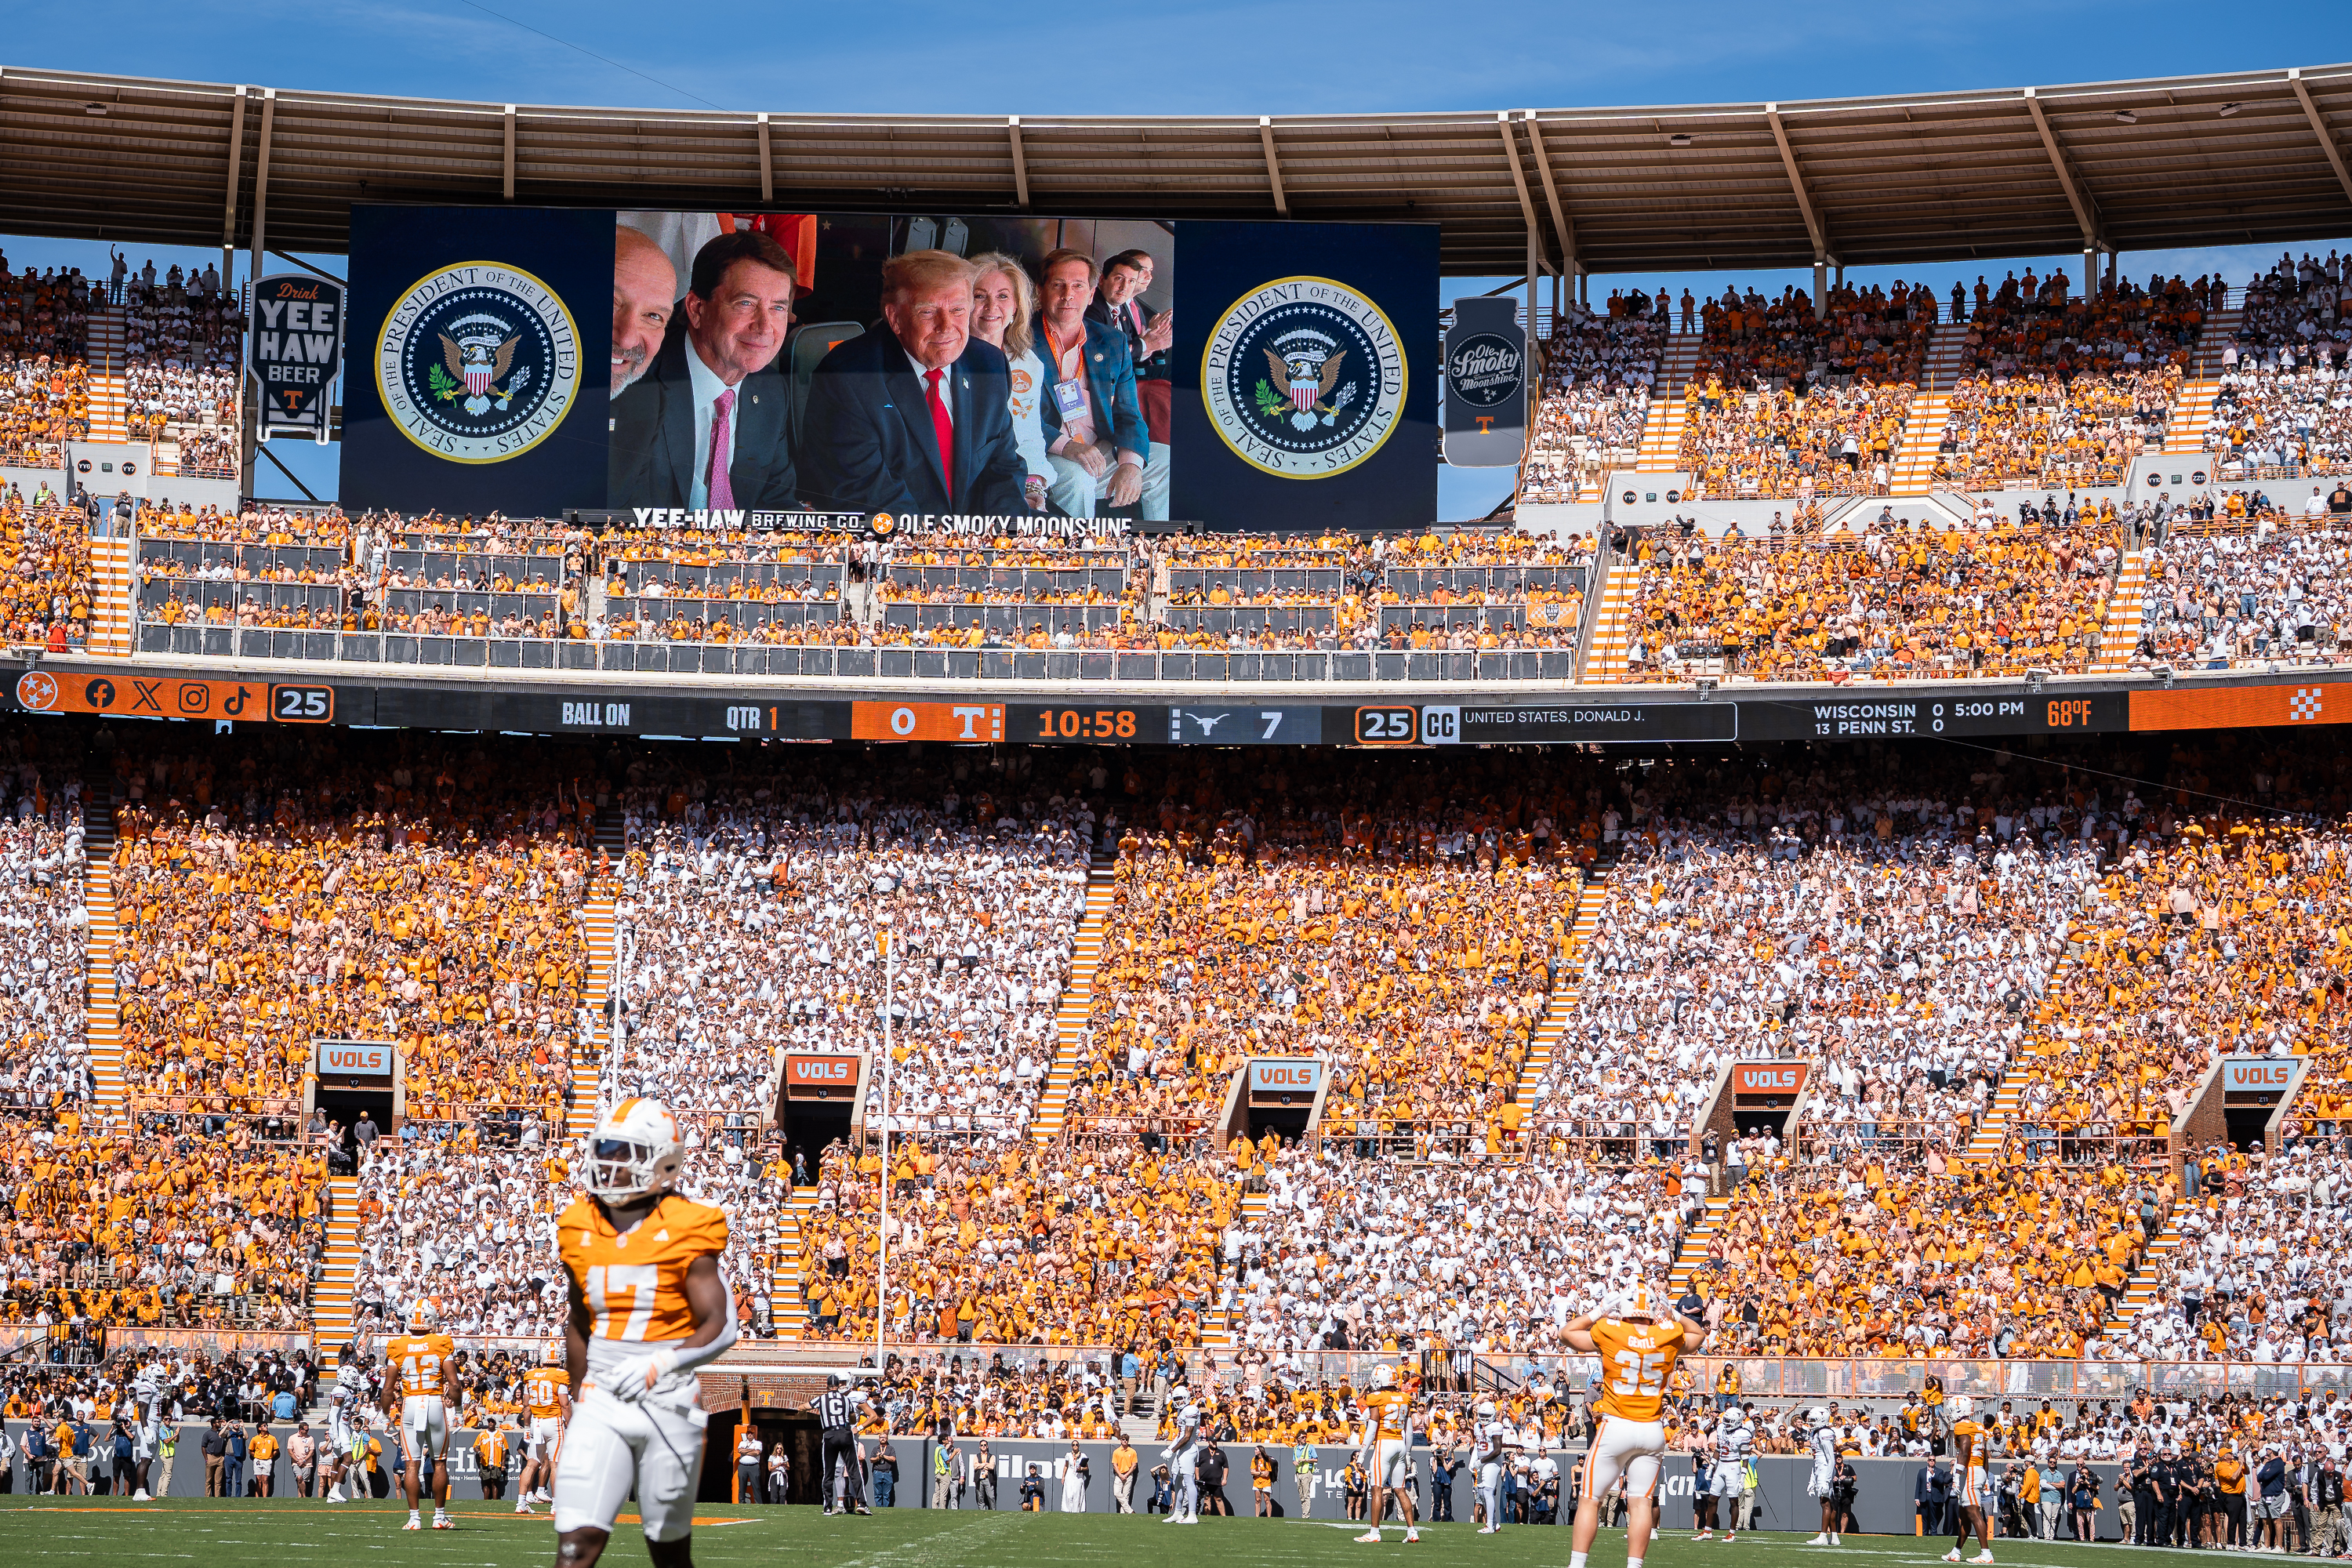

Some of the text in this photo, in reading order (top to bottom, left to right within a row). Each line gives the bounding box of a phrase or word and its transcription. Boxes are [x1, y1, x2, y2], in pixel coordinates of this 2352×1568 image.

[486, 271, 506, 283] OF
[509, 276, 535, 297] THE
[277, 282, 319, 300] Drink
[1309, 286, 1330, 298] OF
[1333, 291, 1360, 313] THE
[259, 299, 334, 332] YEE
[383, 267, 478, 354] PRESIDENT
[536, 293, 575, 379] UNITED
[1209, 283, 1302, 370] PRESIDENT
[260, 331, 335, 364] HAW
[1361, 308, 1400, 396] UNITED
[1475, 343, 1499, 359] Ole
[268, 365, 320, 384] BEER
[1451, 348, 1520, 378] Smoky
[1460, 372, 1519, 390] Moonshine
[284, 390, 303, 409] T
[405, 412, 458, 453] SEAL
[496, 391, 566, 453] STATES
[1475, 416, 1494, 434] T
[1234, 426, 1286, 468] SEAL
[1324, 406, 1392, 469] STATES
[633, 507, 866, 528] YEE-HAW BREWING CO.
[900, 514, 1132, 538] OLE SMOKY MOONSHINE
[280, 690, 327, 716] 25
[561, 702, 630, 726] BALL ON
[1814, 703, 1944, 720] WISCONSIN 0
[1955, 702, 2024, 717] 5:00 PM
[726, 706, 777, 731] QTR 1
[891, 706, 985, 739] 0 T
[1039, 710, 1136, 738] 10:58
[1261, 712, 1283, 739] 7
[1365, 712, 1409, 737] 25
[1426, 712, 1454, 738] CC
[1465, 710, 1646, 724] UNITED STATES, DONALD J.
[1815, 719, 1944, 735] 13 PENN ST. 0
[329, 1051, 382, 1068] VOLS
[797, 1062, 848, 1079] VOLS
[1260, 1069, 1312, 1084] VOLS
[1744, 1071, 1796, 1087] VOLS
[2234, 1068, 2288, 1084] VOLS
[586, 1264, 659, 1341] 17
[407, 1342, 429, 1353] BURKS
[1628, 1335, 1657, 1349] GENTLE
[401, 1354, 441, 1390] 42
[1613, 1349, 1665, 1396] 35
[528, 1379, 554, 1406] 50
[759, 1391, 775, 1405] T
[829, 1399, 843, 1415] C
